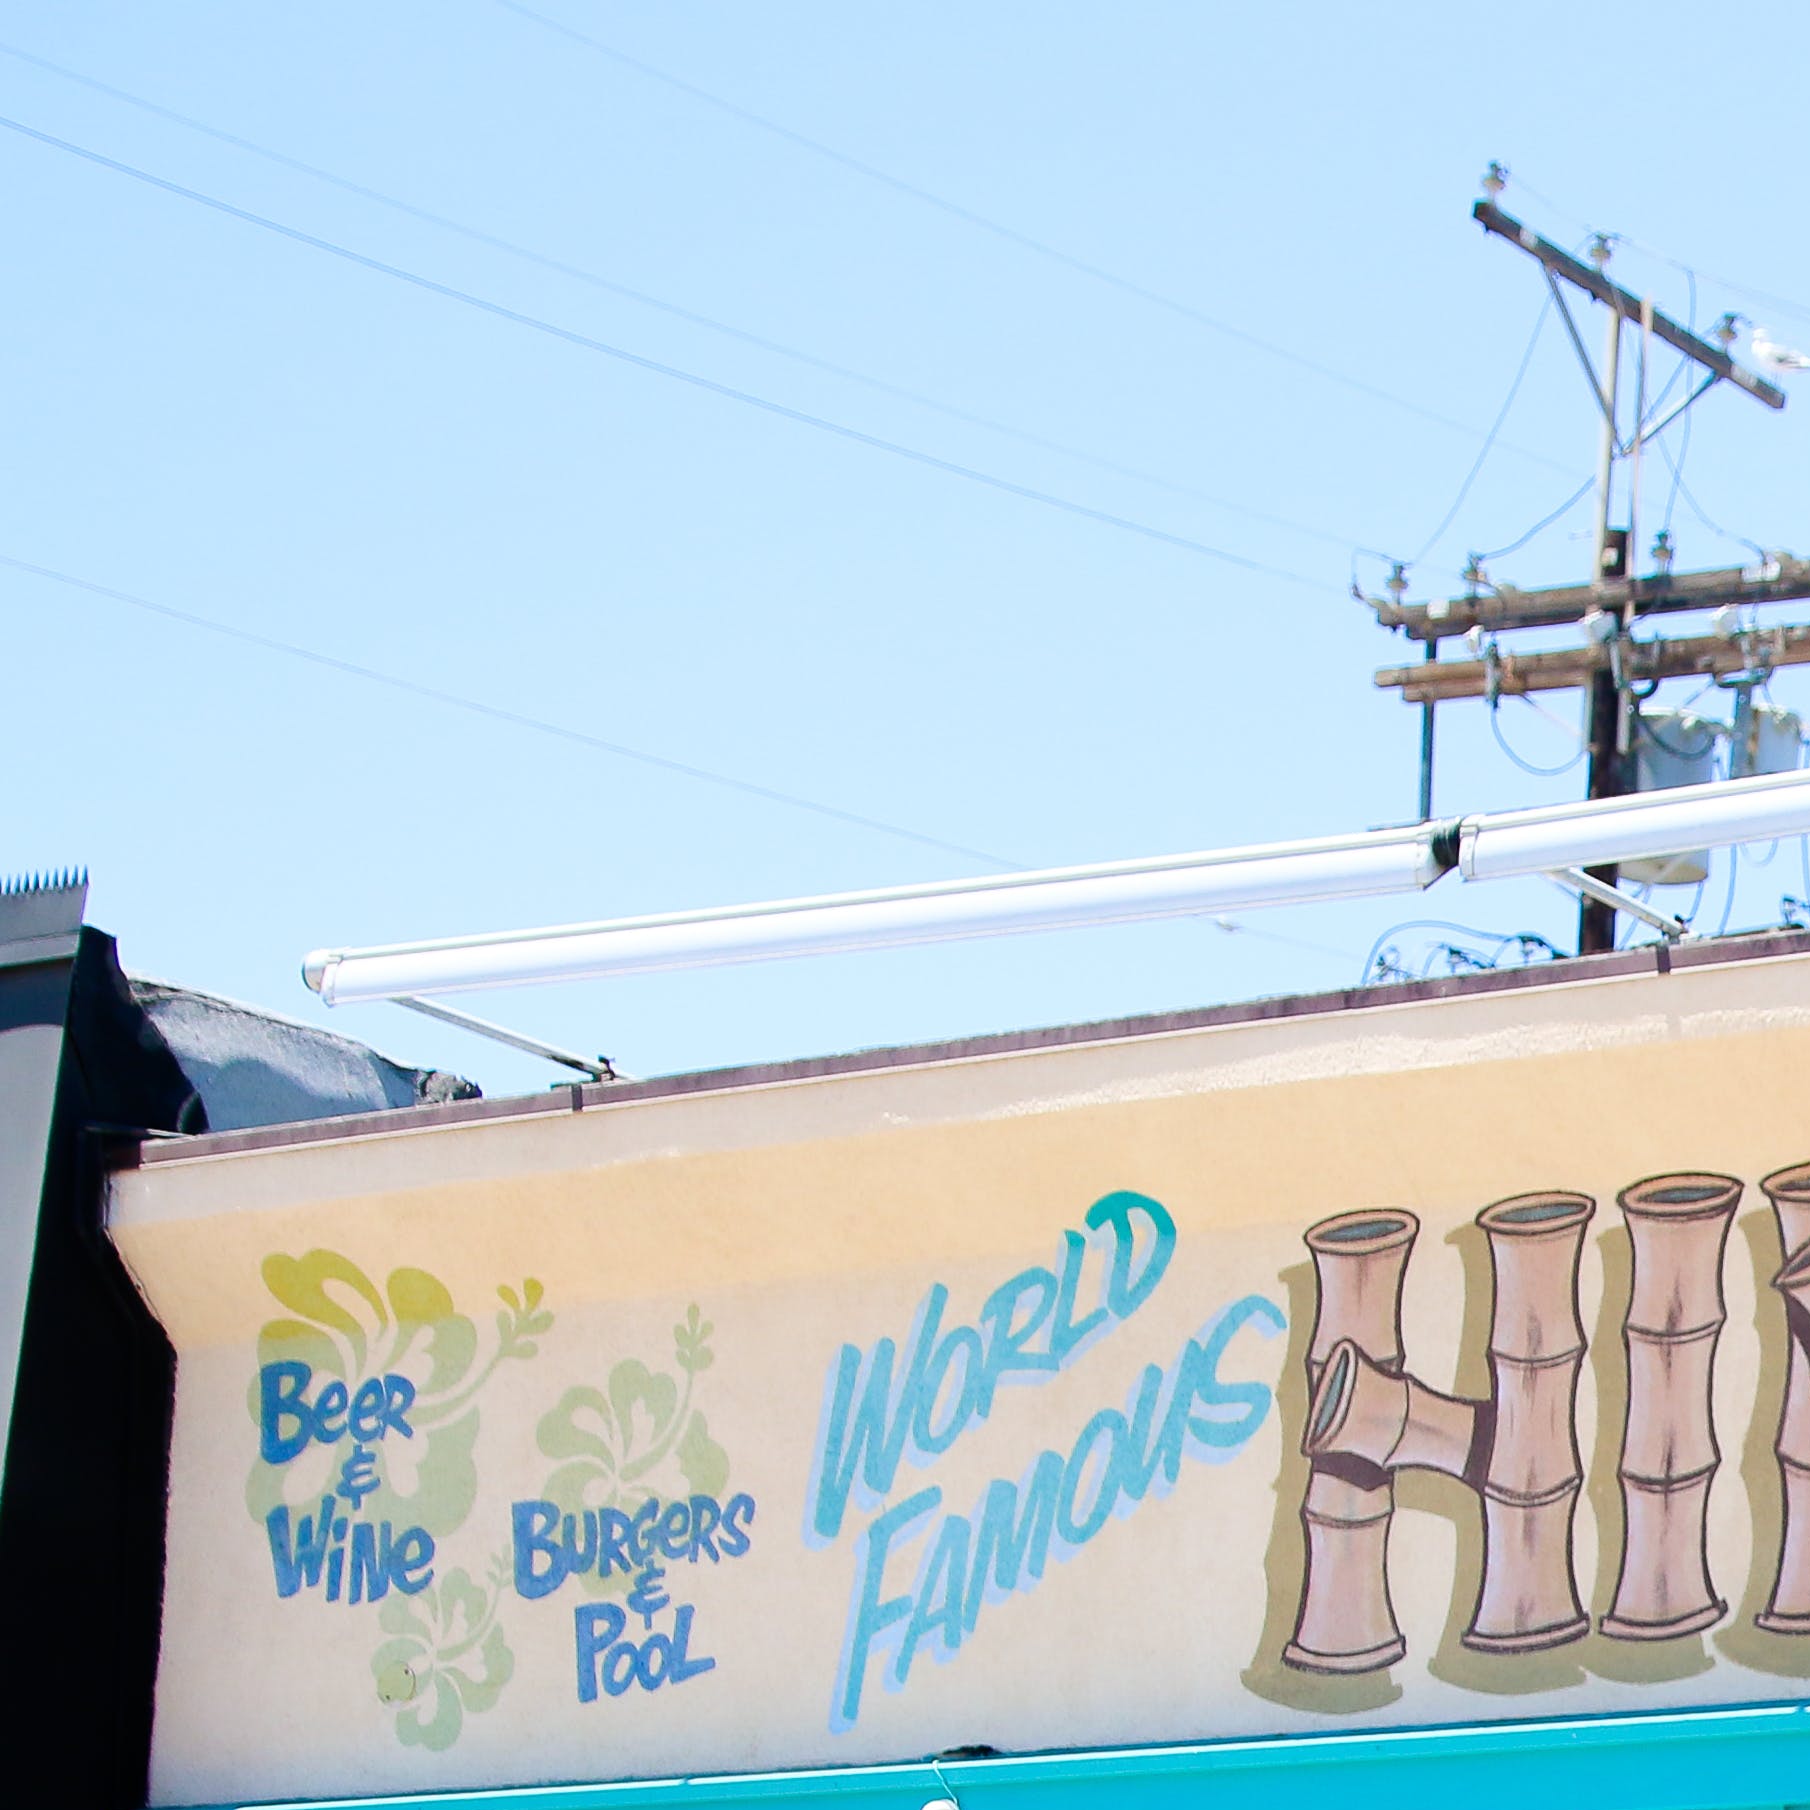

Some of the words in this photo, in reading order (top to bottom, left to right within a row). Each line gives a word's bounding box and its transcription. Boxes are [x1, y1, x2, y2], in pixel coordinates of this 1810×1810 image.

[806, 1189, 1177, 1545] WORLD
[337, 1445, 380, 1509] &
[830, 1295, 1287, 1730] FAMOUS
[627, 1559, 670, 1629] &
